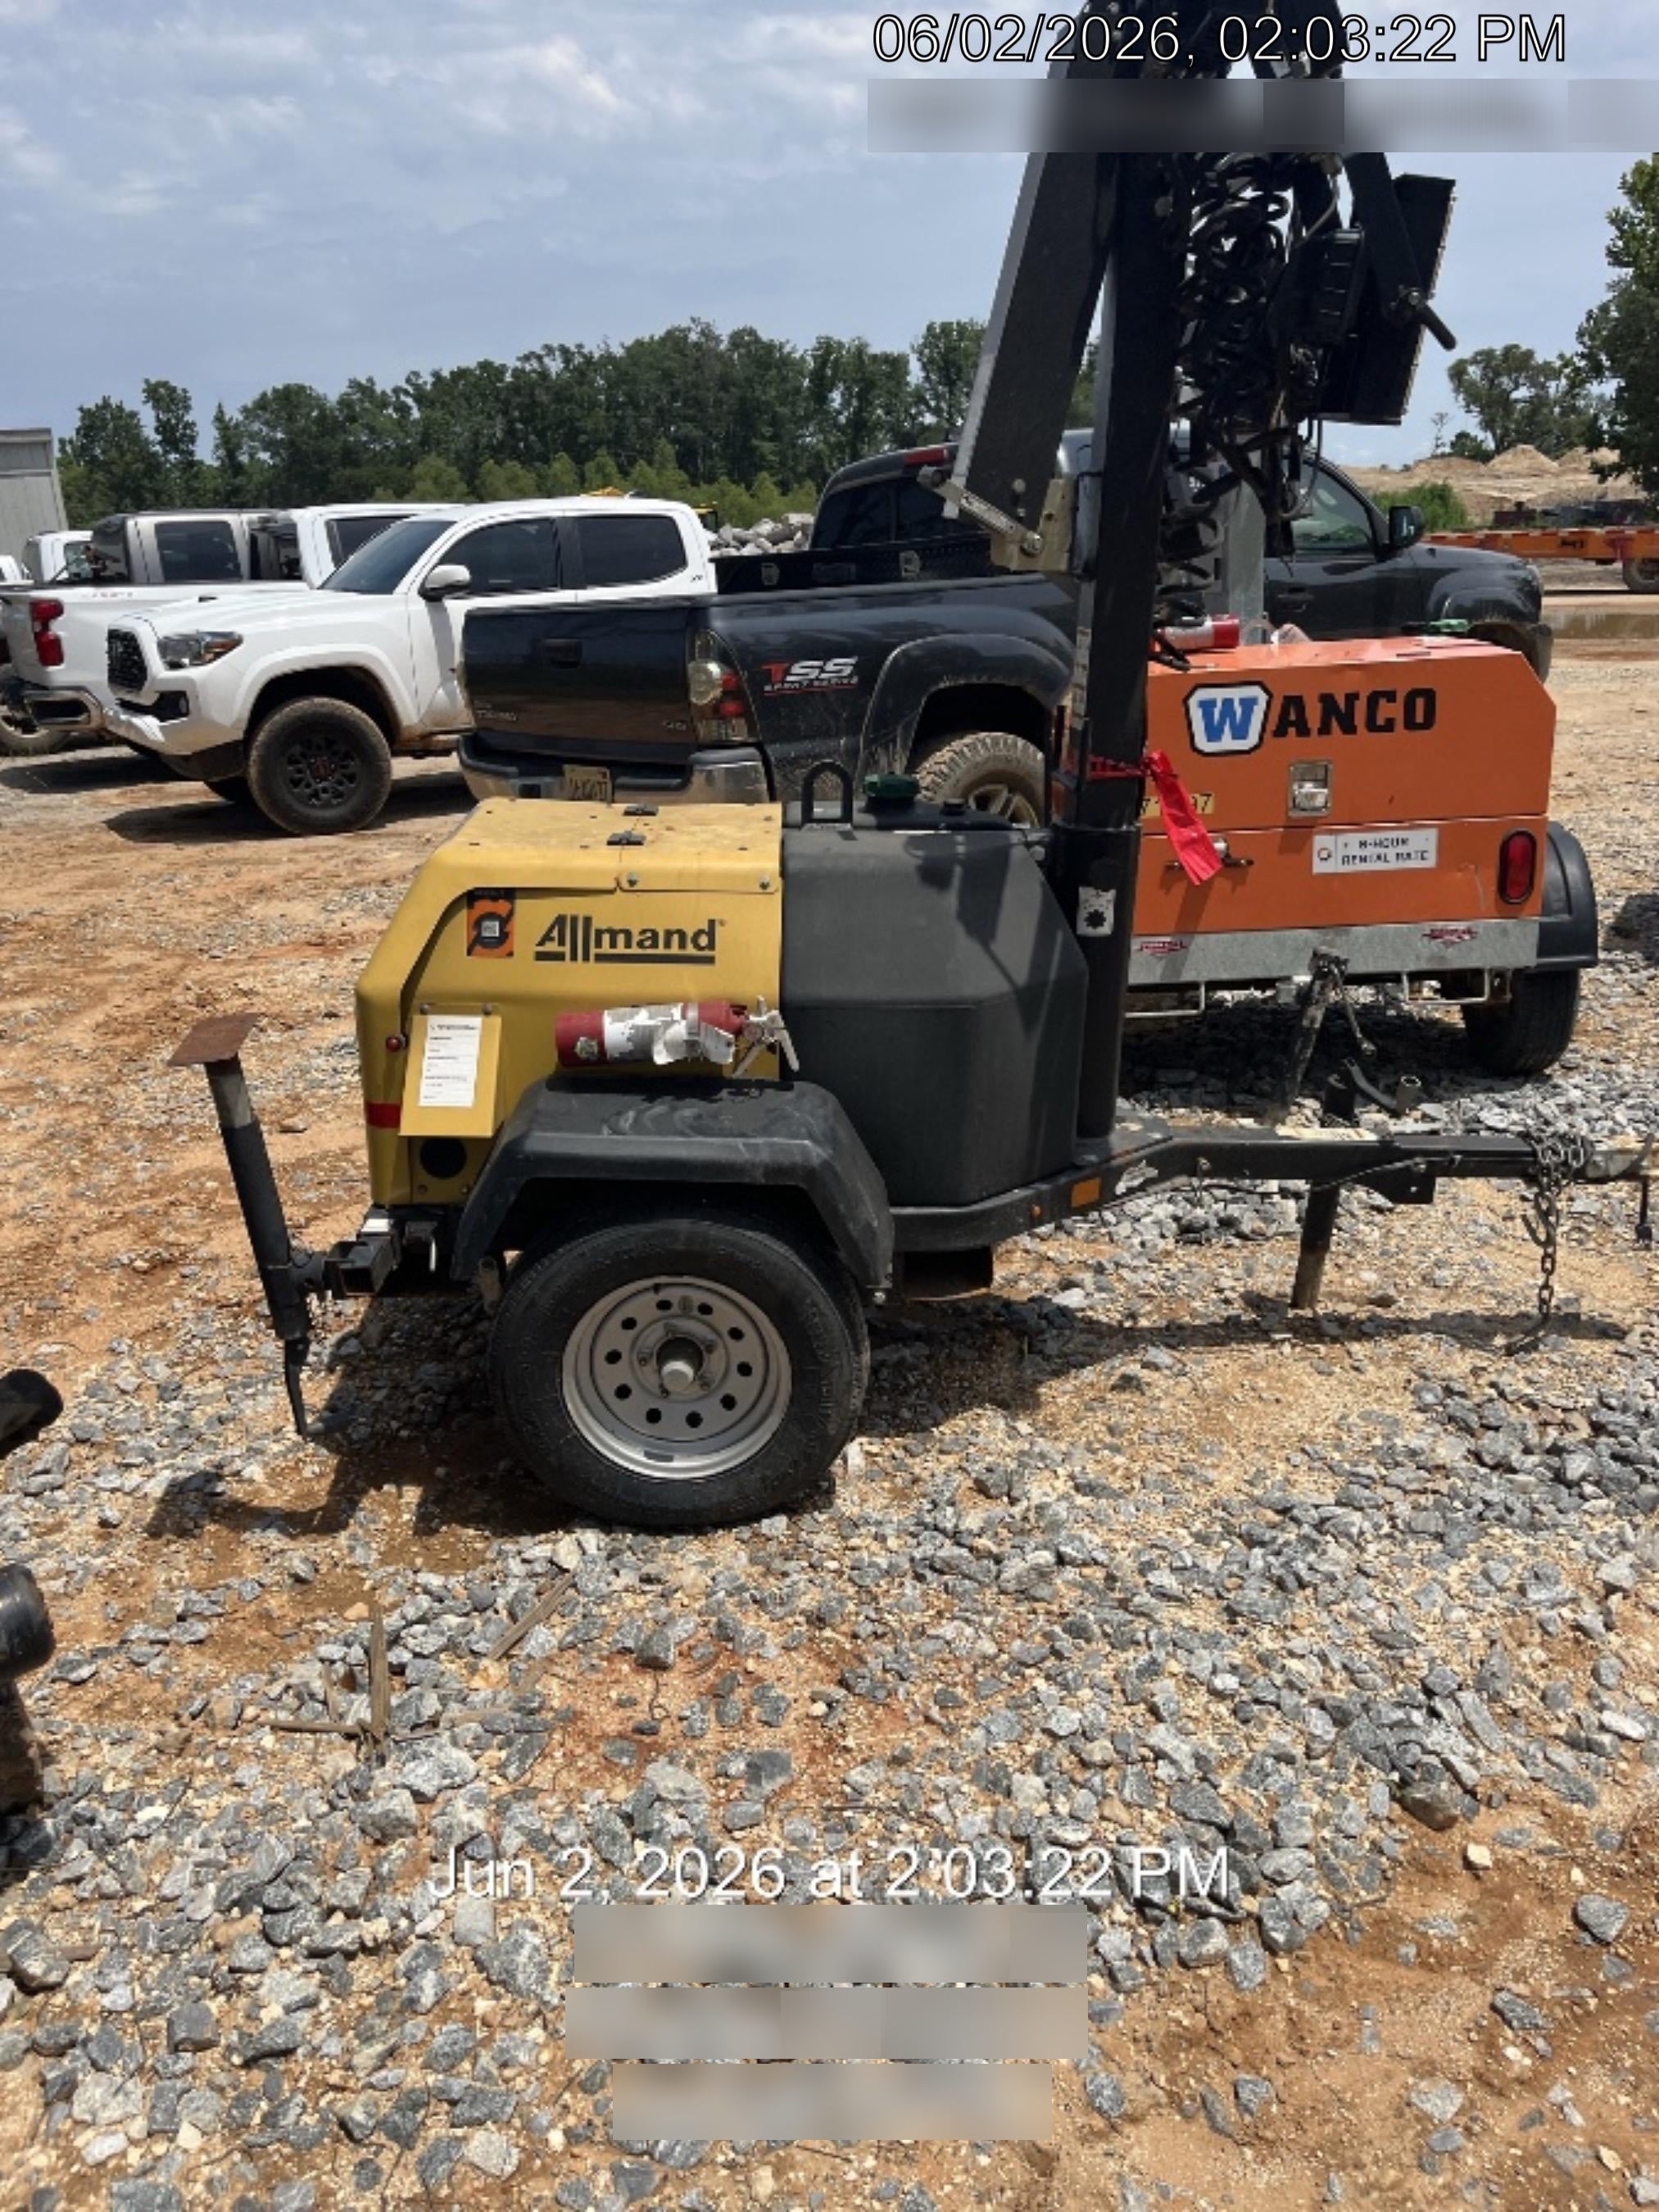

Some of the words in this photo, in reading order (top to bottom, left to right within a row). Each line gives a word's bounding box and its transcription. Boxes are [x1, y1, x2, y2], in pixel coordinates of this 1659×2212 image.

[761, 655, 859, 684] TSS
[1197, 687, 1437, 743] WANCO
[535, 914, 717, 963] Allmand
